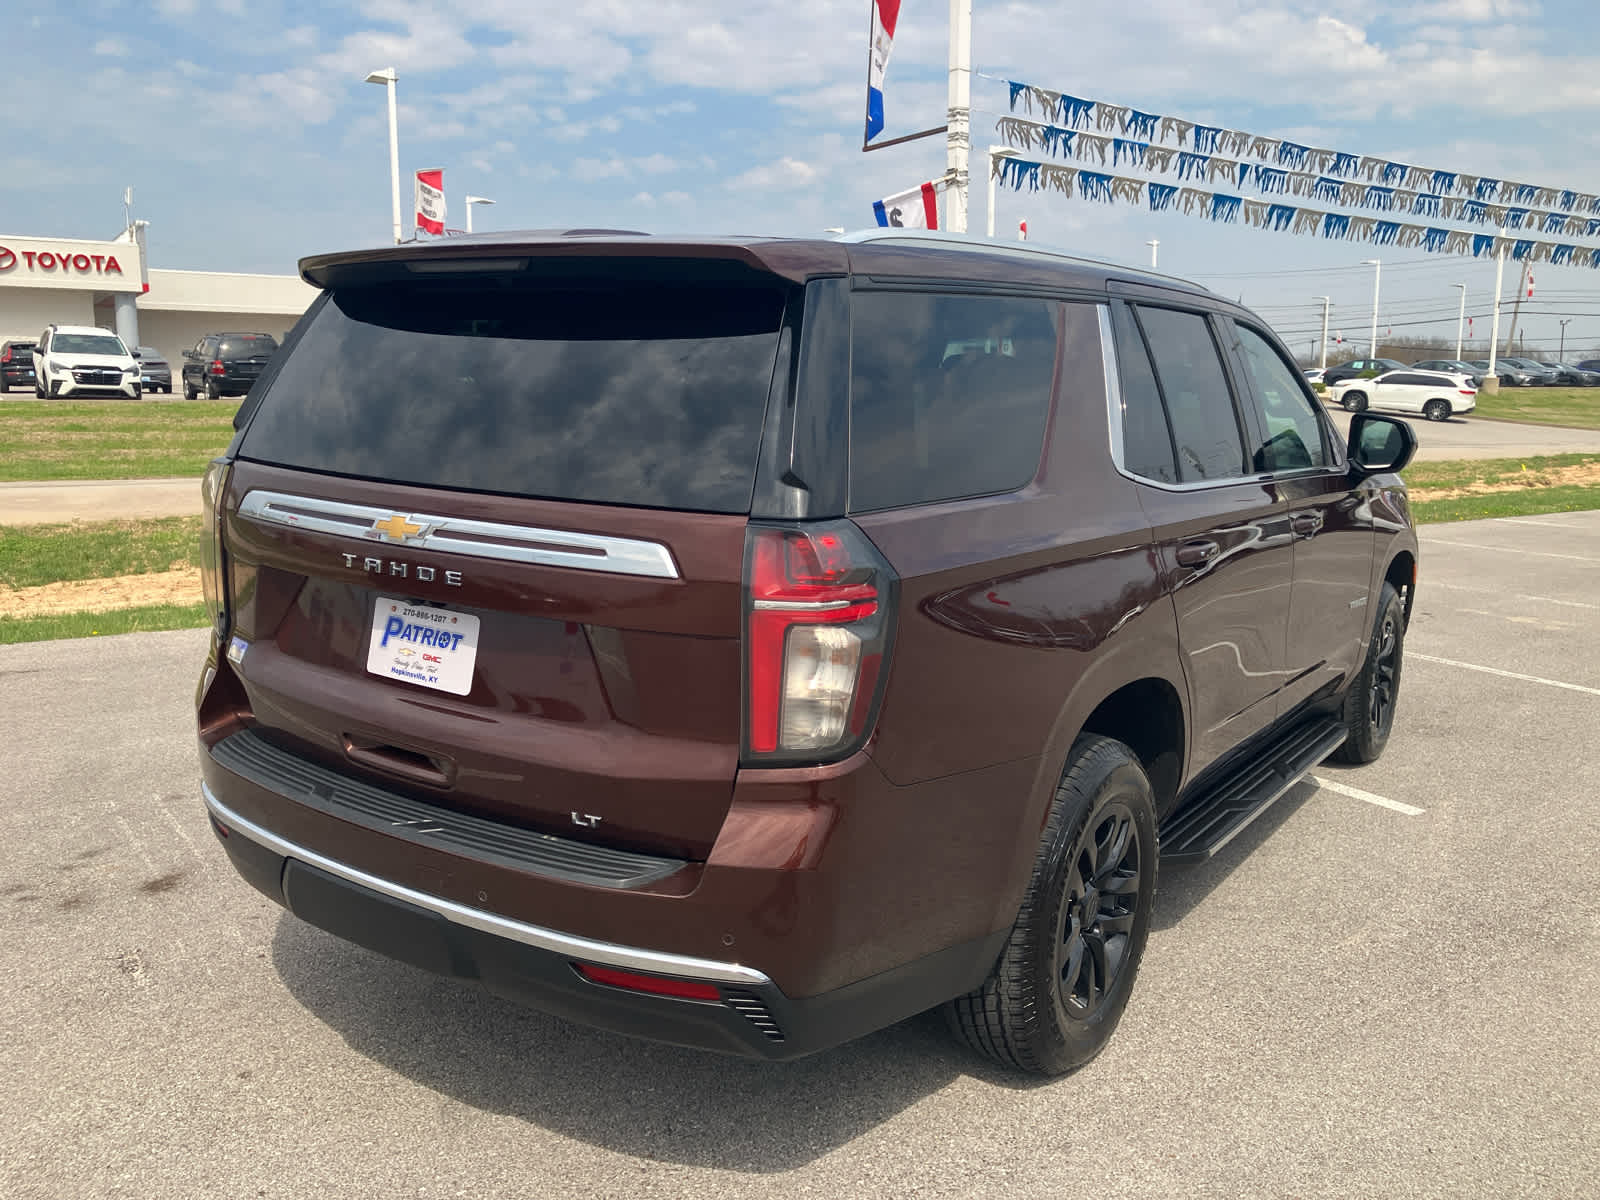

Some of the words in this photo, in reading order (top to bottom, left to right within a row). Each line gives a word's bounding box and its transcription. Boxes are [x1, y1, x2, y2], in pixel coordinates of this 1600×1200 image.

[21, 251, 122, 273] TOYOTA
[342, 552, 462, 587] TAHOE
[381, 615, 464, 651] PATRIOT
[422, 653, 442, 664] GMC
[391, 666, 427, 682] Hopkinsville,
[428, 674, 439, 683] KY
[571, 811, 602, 829] LT
